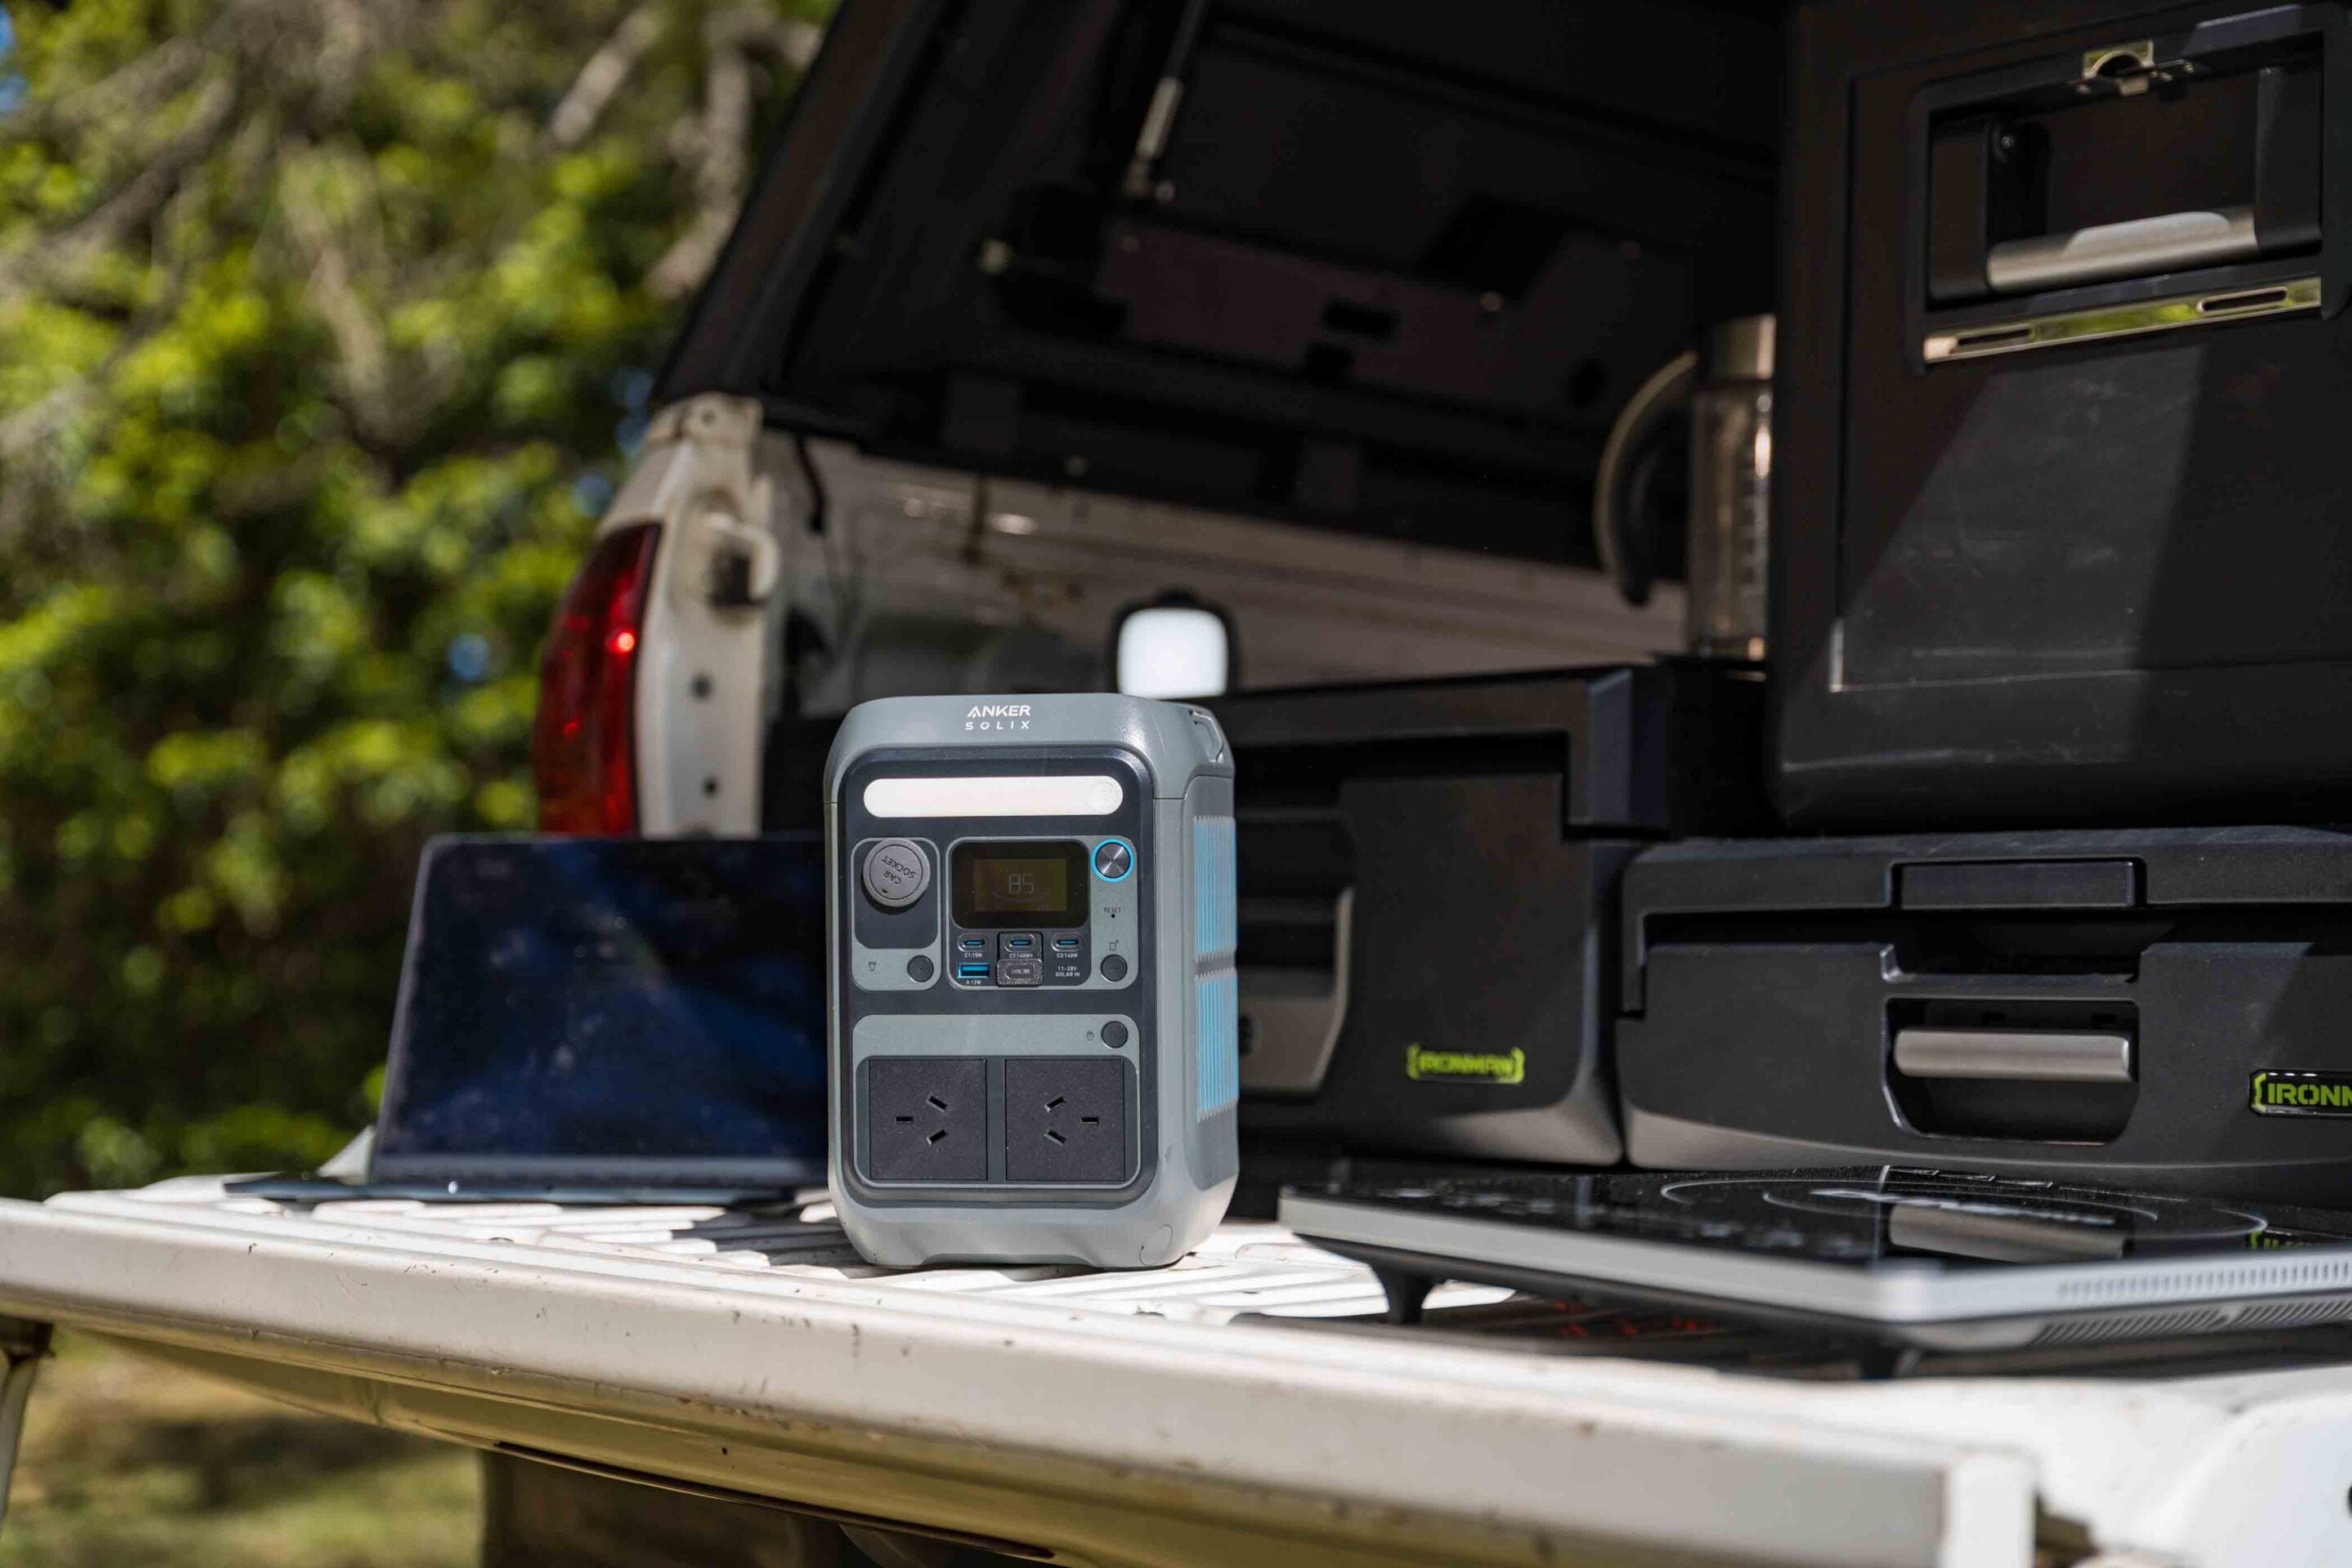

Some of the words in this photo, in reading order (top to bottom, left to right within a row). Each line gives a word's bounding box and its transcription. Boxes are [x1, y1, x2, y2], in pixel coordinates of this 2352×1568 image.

[967, 705, 1031, 719] ANKER
[964, 720, 1030, 730] SOLIX
[881, 855, 916, 879] SOCKET
[883, 870, 902, 884] CAR
[1009, 873, 1034, 894] 85
